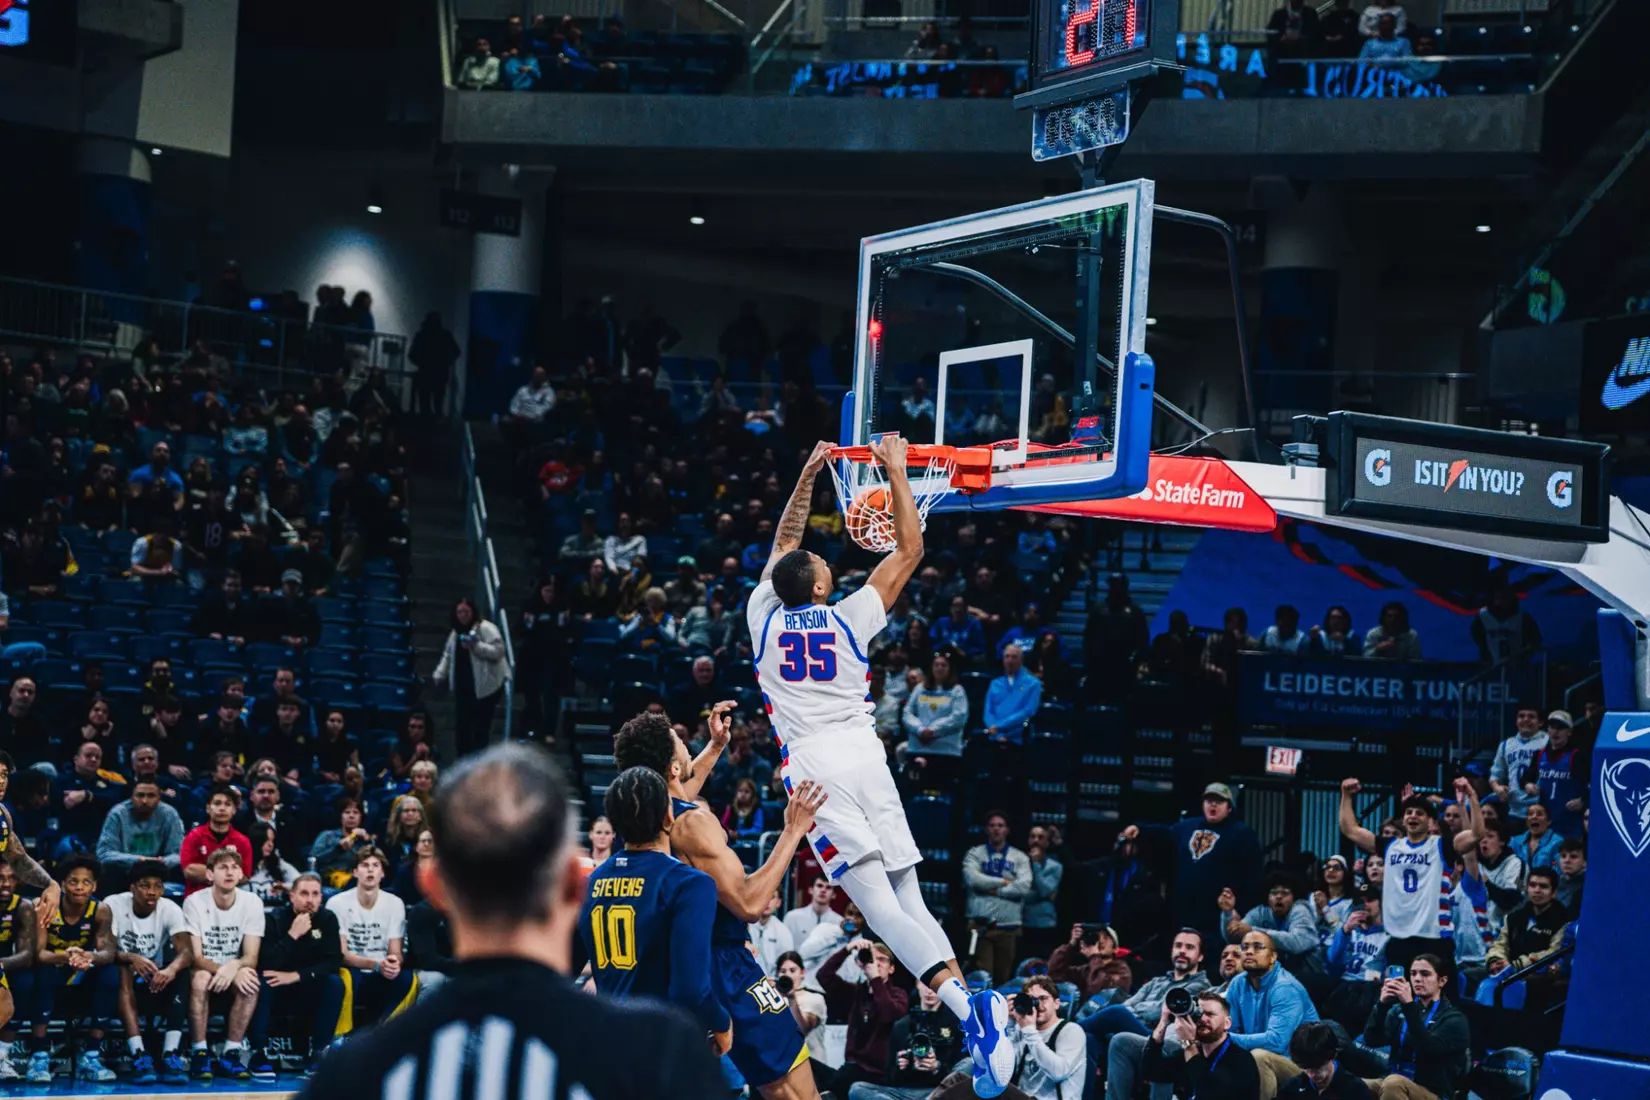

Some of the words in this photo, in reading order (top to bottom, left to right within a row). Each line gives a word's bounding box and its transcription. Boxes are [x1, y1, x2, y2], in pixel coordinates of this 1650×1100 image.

[1364, 449, 1392, 487] G
[1479, 468, 1525, 496] YOU?
[1546, 470, 1573, 508] G
[784, 610, 828, 630] BENSON
[778, 632, 837, 682] 35
[1263, 671, 1405, 700] LEIDECKER
[1412, 679, 1520, 703] TUNNEL
[1270, 747, 1297, 766] EXIT
[1549, 782, 1557, 800] 1
[592, 877, 645, 898] STEVENS
[1403, 869, 1418, 893] 0
[591, 904, 638, 970] 10
